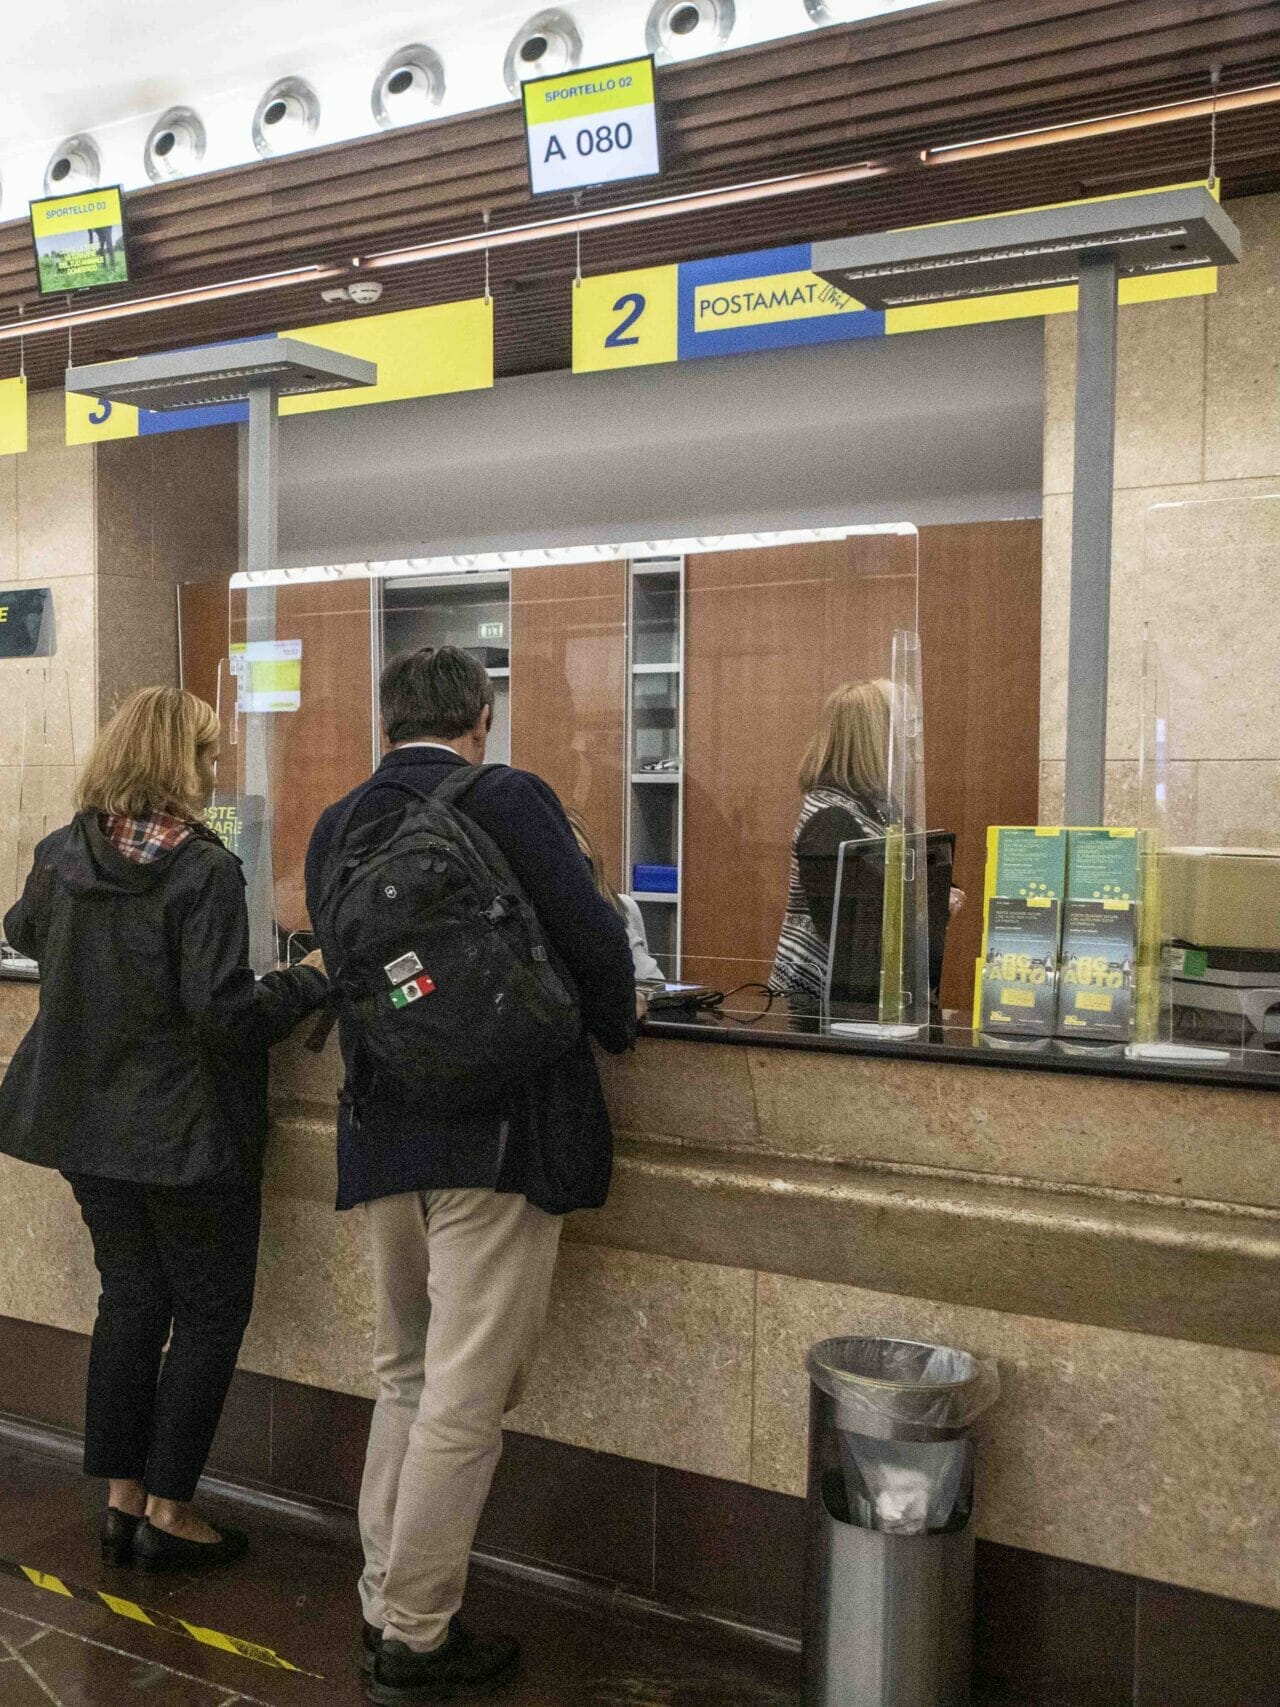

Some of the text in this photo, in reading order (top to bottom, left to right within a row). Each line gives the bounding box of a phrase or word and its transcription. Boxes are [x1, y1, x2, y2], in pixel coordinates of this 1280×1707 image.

[545, 76, 633, 103] SPORTELLO 02
[543, 122, 633, 164] A 080
[46, 203, 95, 219] SPORTELLO
[604, 292, 646, 349] 2
[700, 283, 818, 319] POSTAMAT
[203, 806, 238, 820] STE
